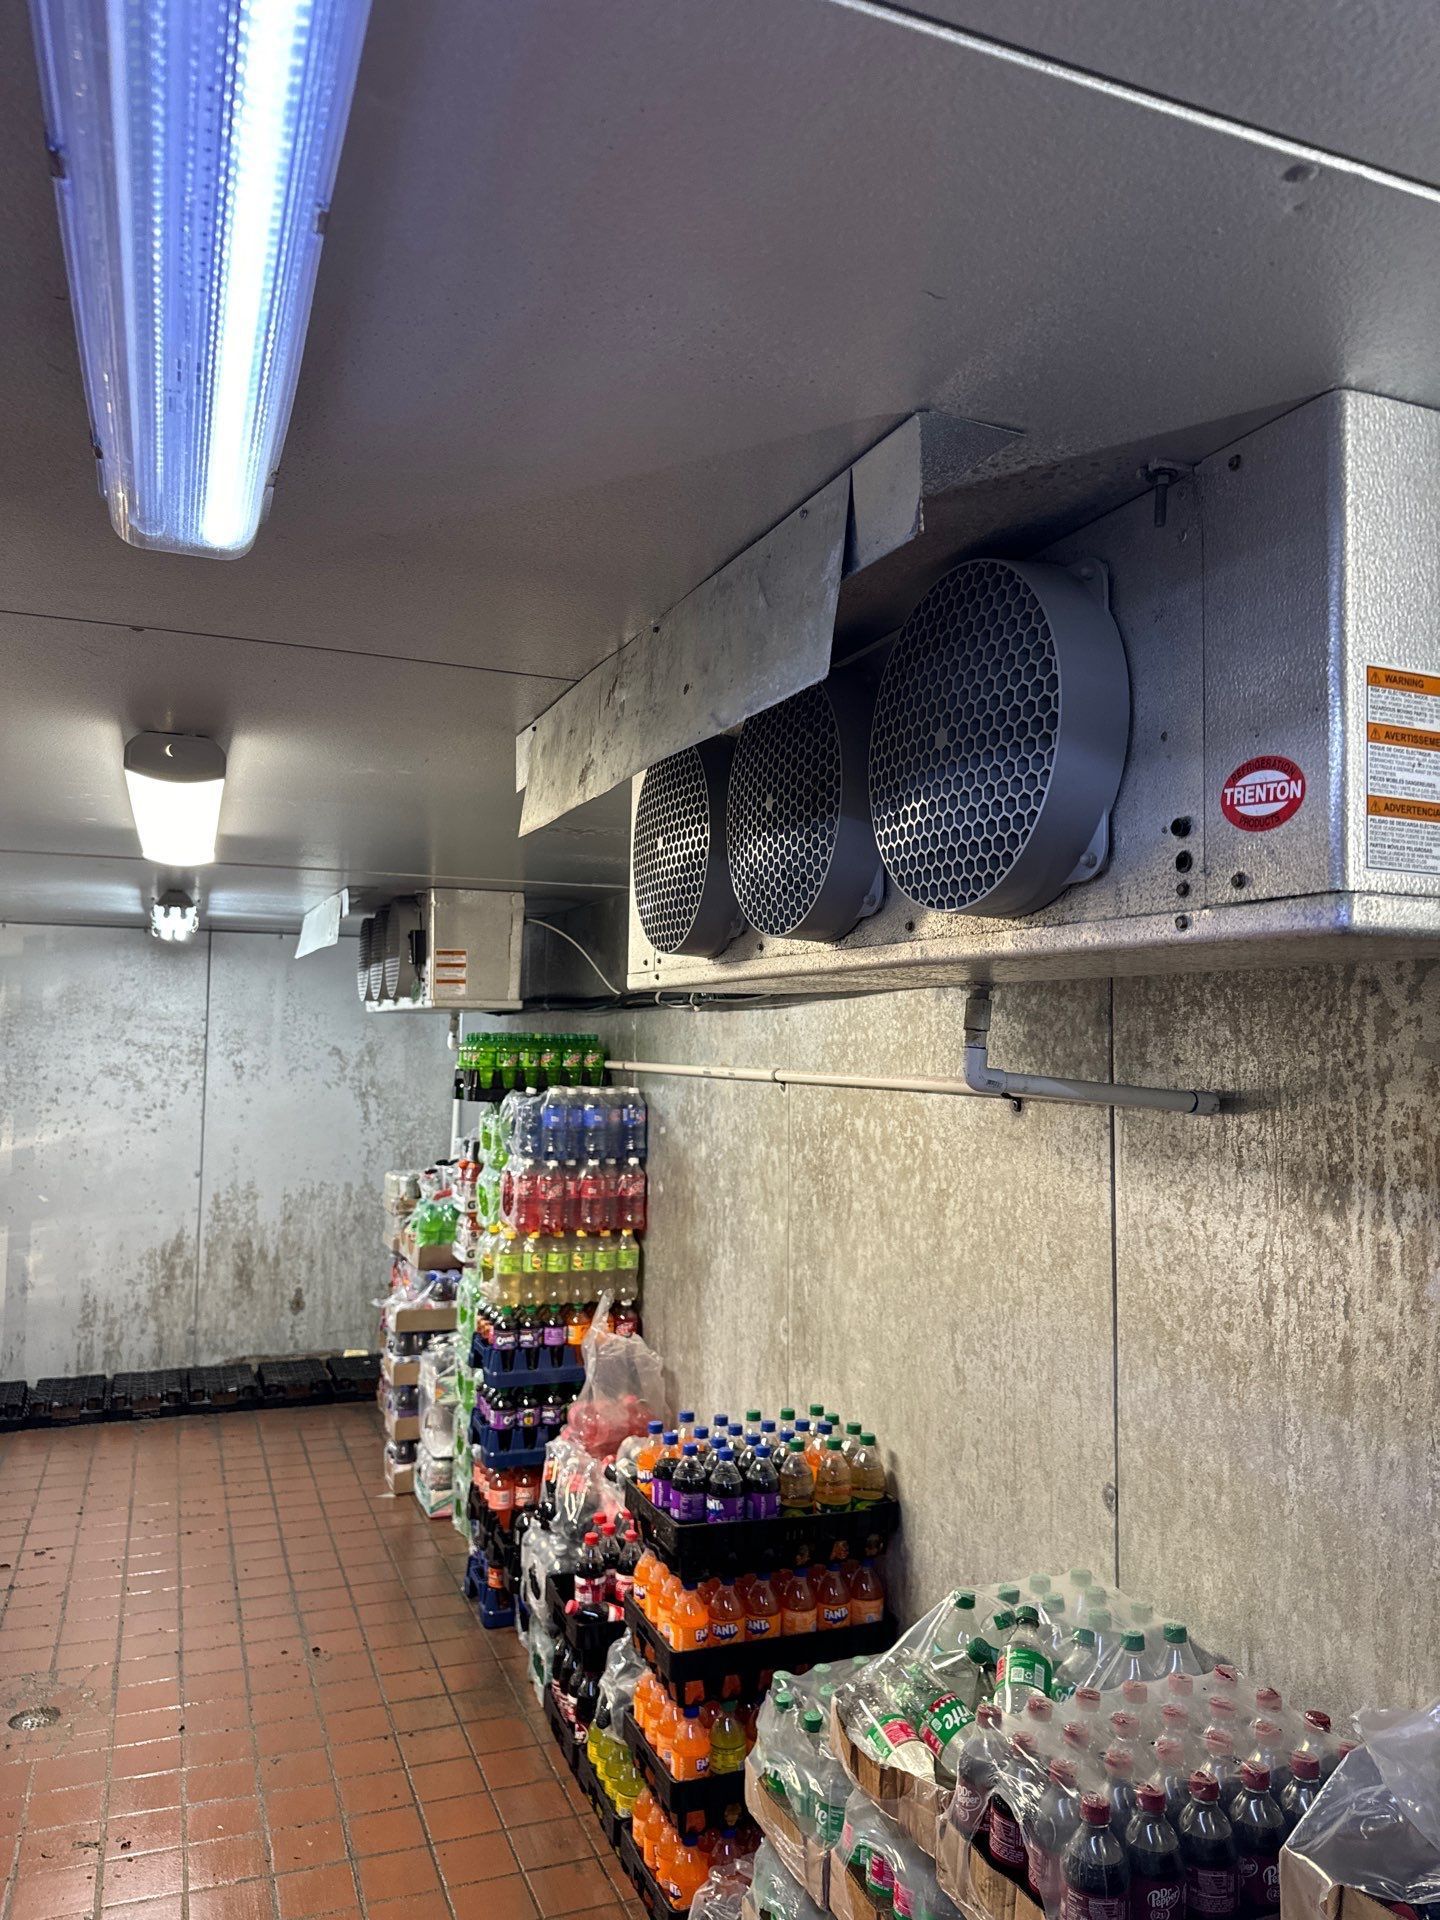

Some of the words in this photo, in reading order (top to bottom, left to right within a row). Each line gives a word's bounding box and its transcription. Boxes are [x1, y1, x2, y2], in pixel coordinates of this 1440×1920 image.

[1384, 674, 1424, 688] WARNING
[1231, 759, 1297, 783] REFRIGERATION
[1224, 780, 1302, 806] TRENTON
[1240, 814, 1280, 828] PRODUCTS
[824, 1607, 848, 1620] FANTA
[712, 1624, 738, 1636] FANTA
[747, 1620, 770, 1630] ANTA
[1147, 1890, 1179, 1908] Pepper
[1160, 1888, 1172, 1898] Dr
